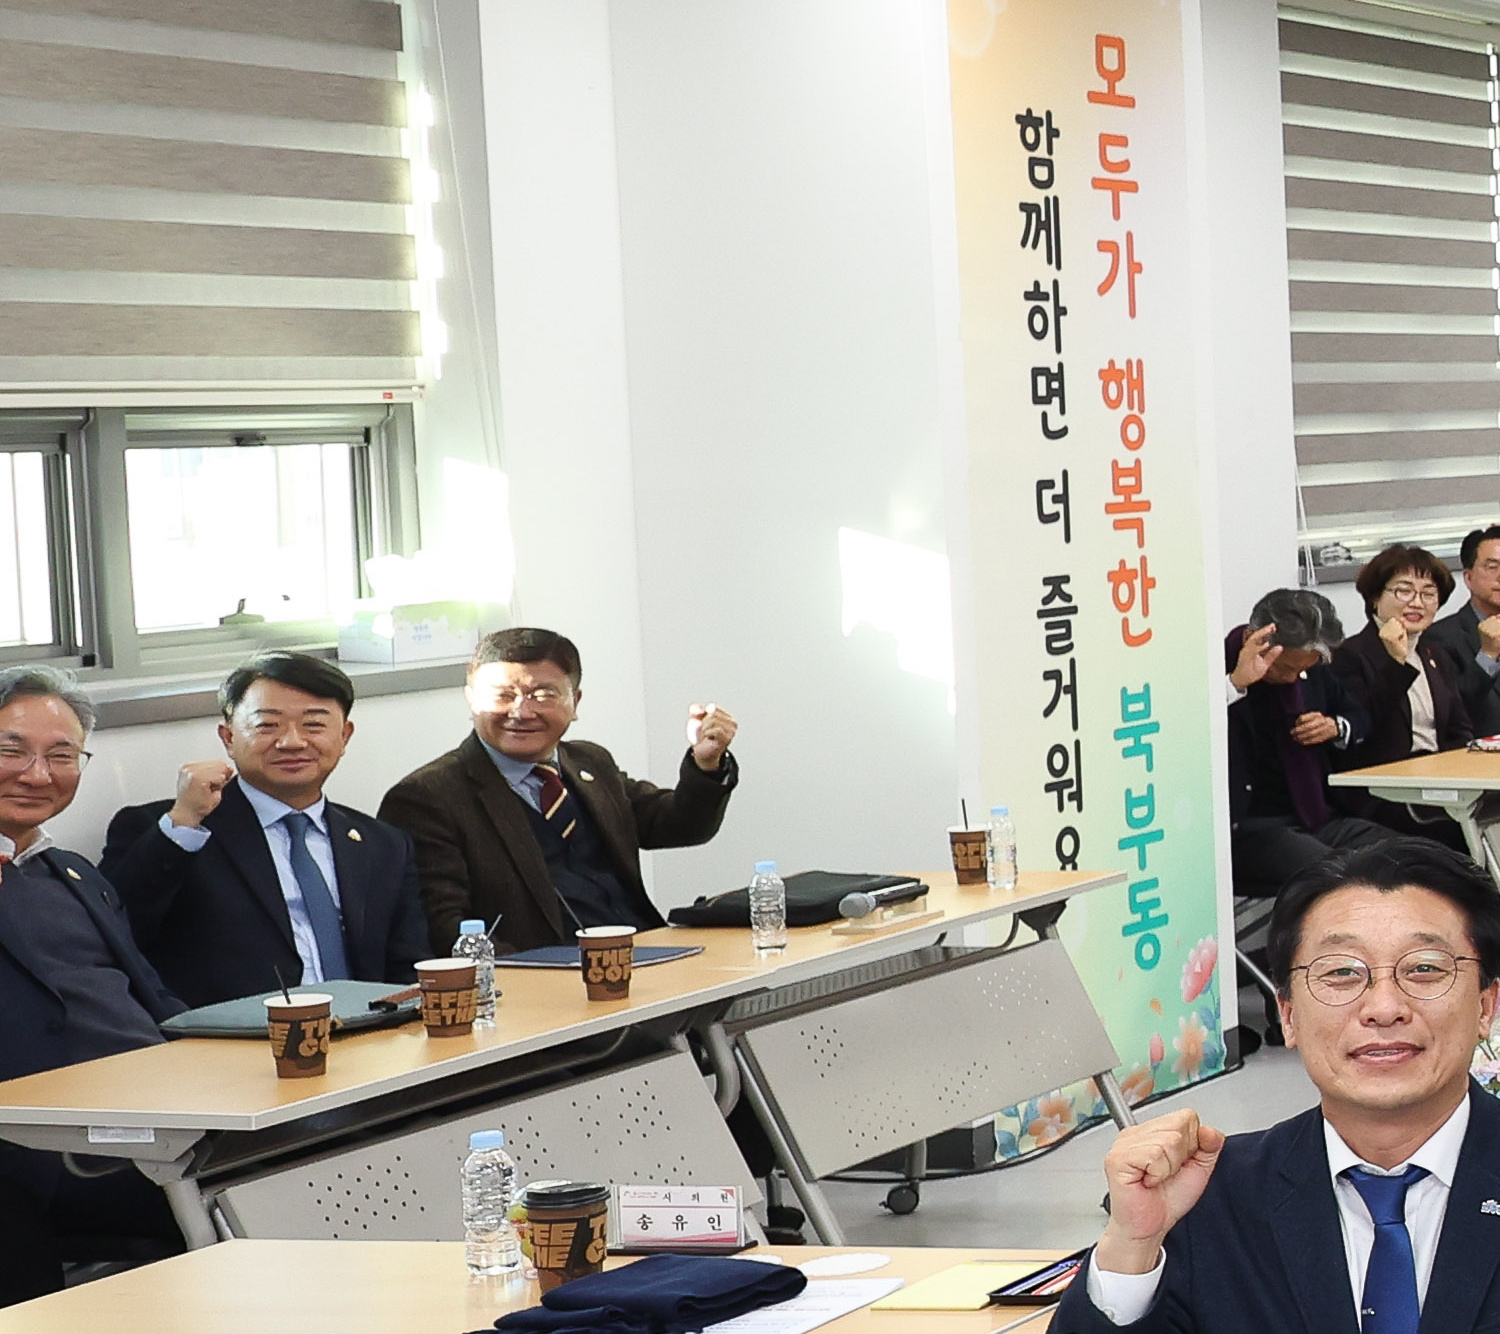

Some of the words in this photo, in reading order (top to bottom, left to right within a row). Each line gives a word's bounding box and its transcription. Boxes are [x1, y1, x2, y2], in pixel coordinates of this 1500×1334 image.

[1014, 107, 1069, 443] 함께하면
[1086, 32, 1143, 322] 모두가
[1036, 470, 1073, 546] 더
[1098, 357, 1157, 651] 행복한
[1036, 573, 1084, 871] 즐거워요
[1112, 682, 1170, 975] 북부동
